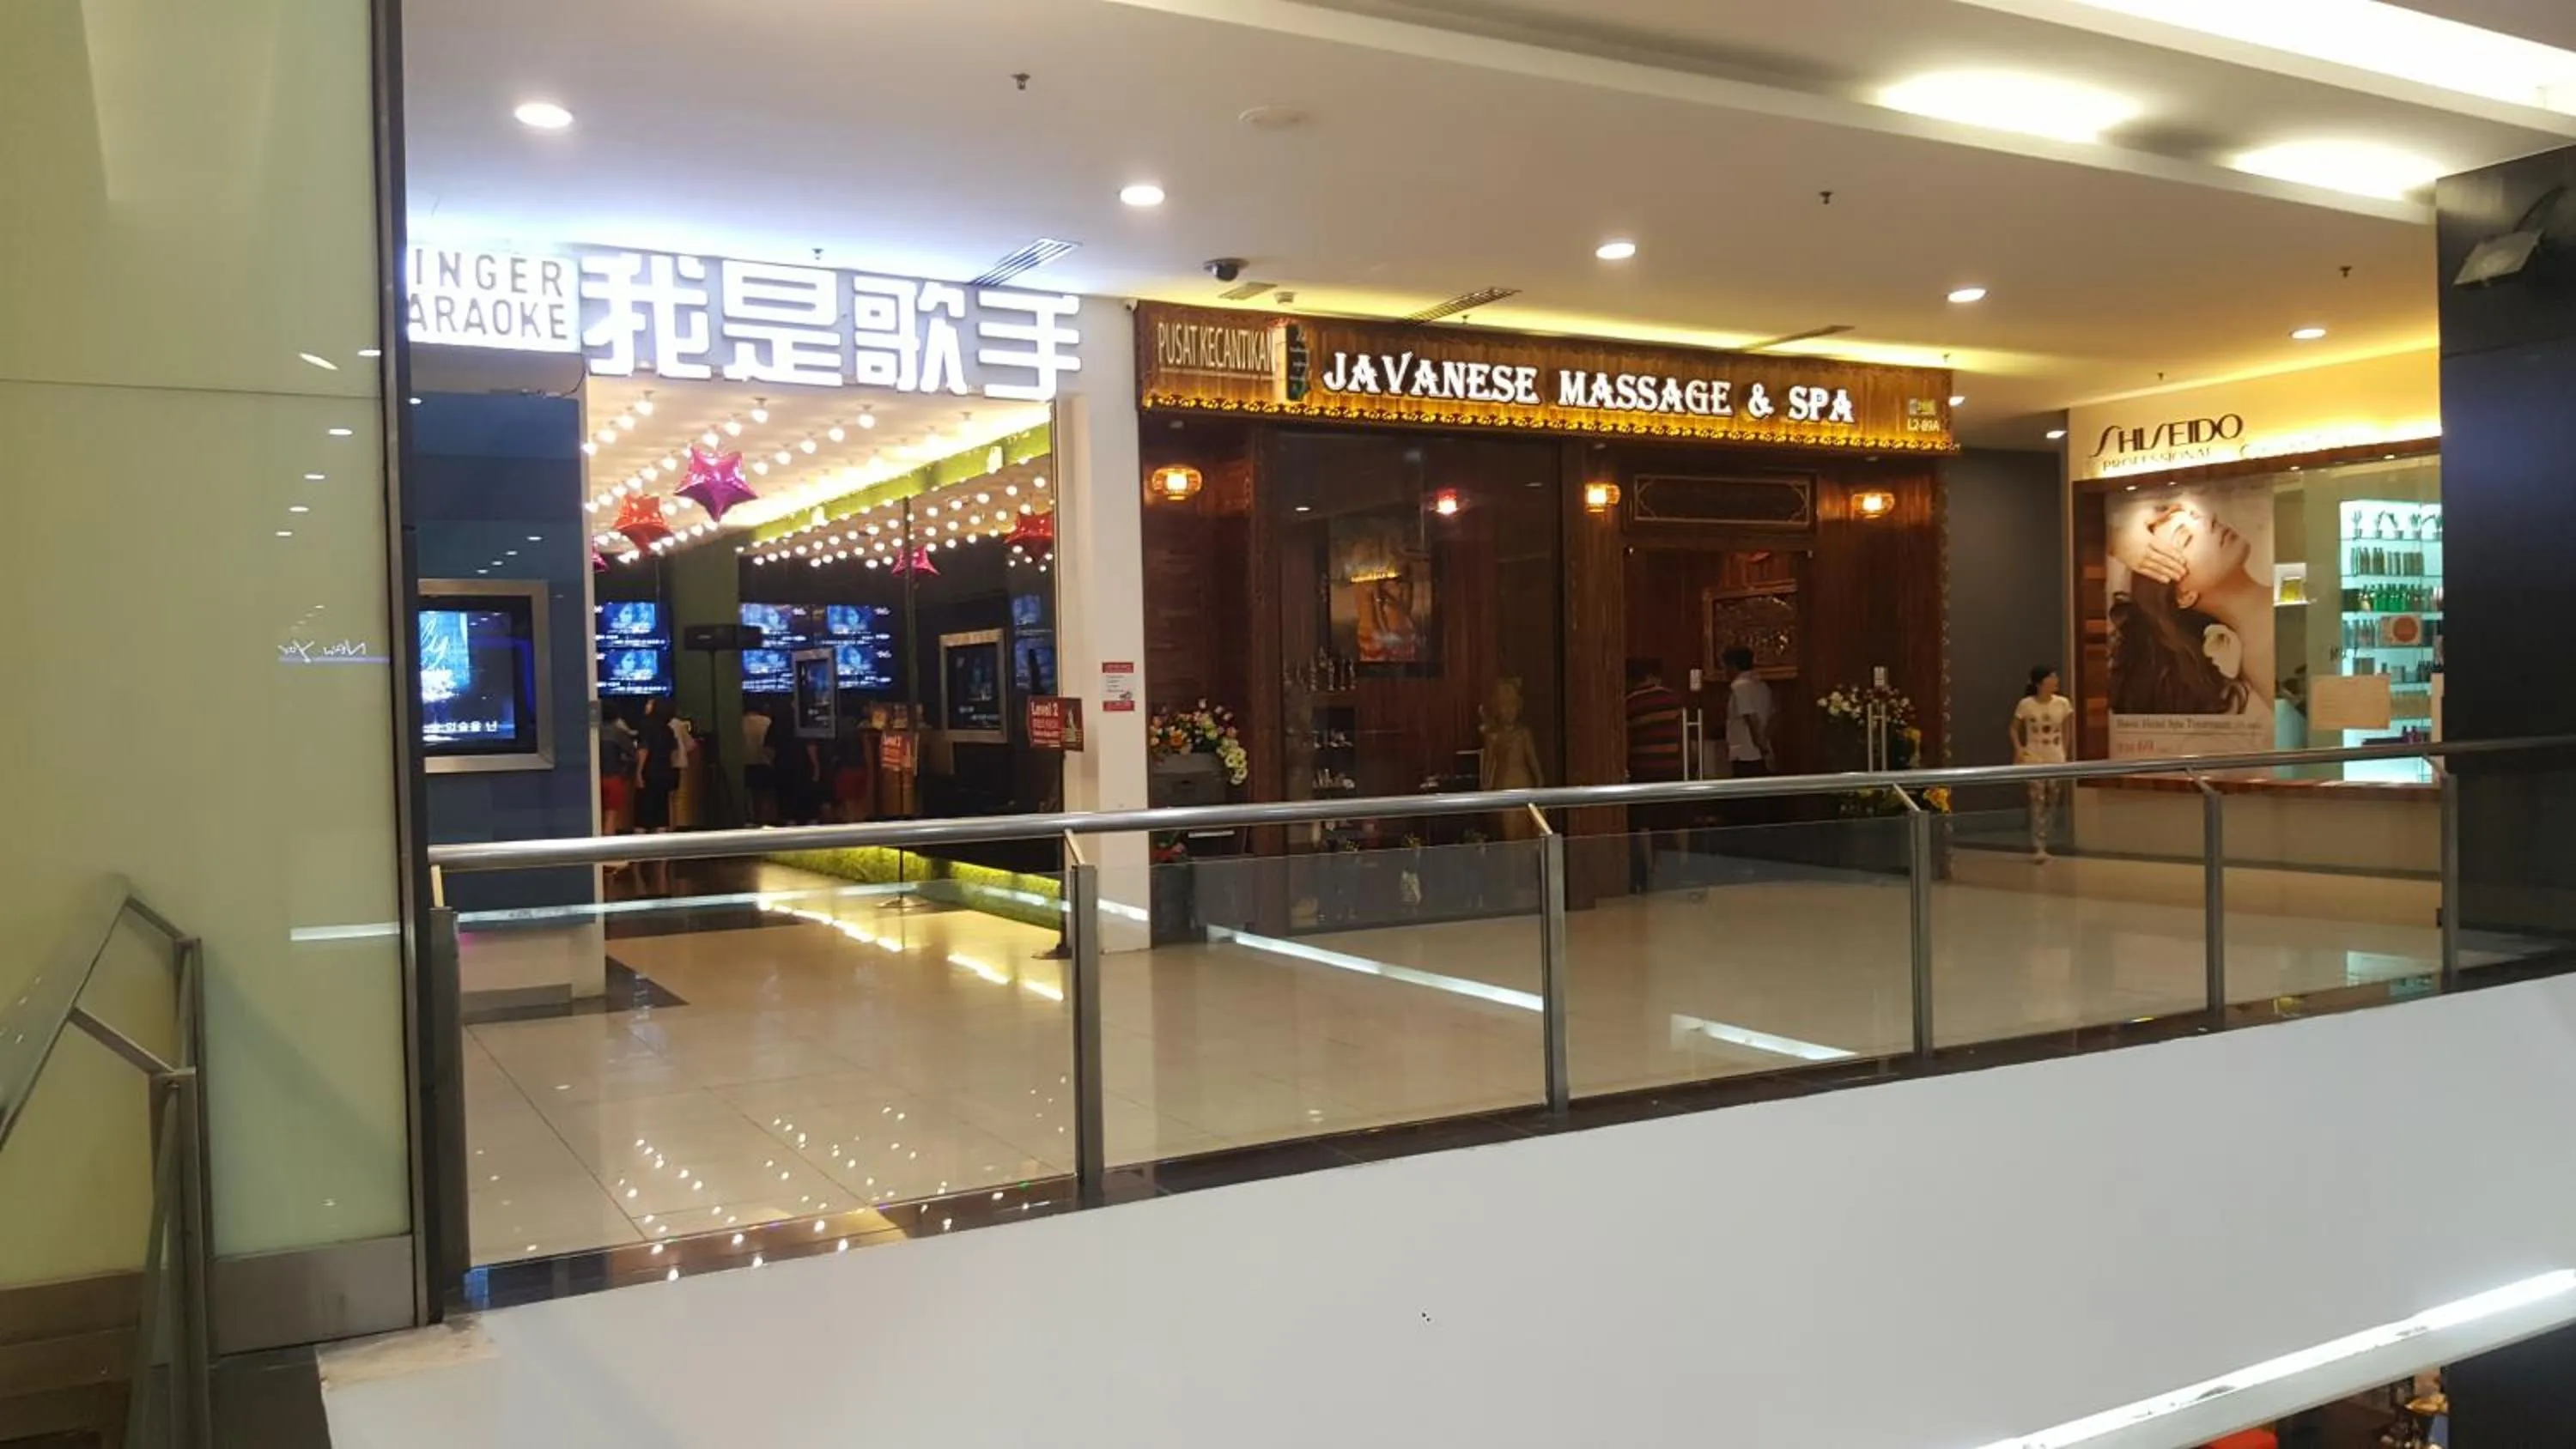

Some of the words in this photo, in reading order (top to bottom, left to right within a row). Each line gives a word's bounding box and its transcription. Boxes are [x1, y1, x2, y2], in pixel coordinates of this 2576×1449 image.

[415, 248, 563, 298] INGER
[408, 293, 568, 340] ARAOKE
[580, 254, 1083, 401] 我是歌手
[1158, 322, 1198, 367] PUSAT
[1200, 325, 1276, 373] KECANTIKAN
[1323, 351, 1540, 404] JAVANESE
[1558, 370, 1733, 416] MASSAGE
[1747, 383, 1775, 419] &
[1788, 385, 1856, 423] SPA
[2088, 413, 2244, 458] SHISEIDO
